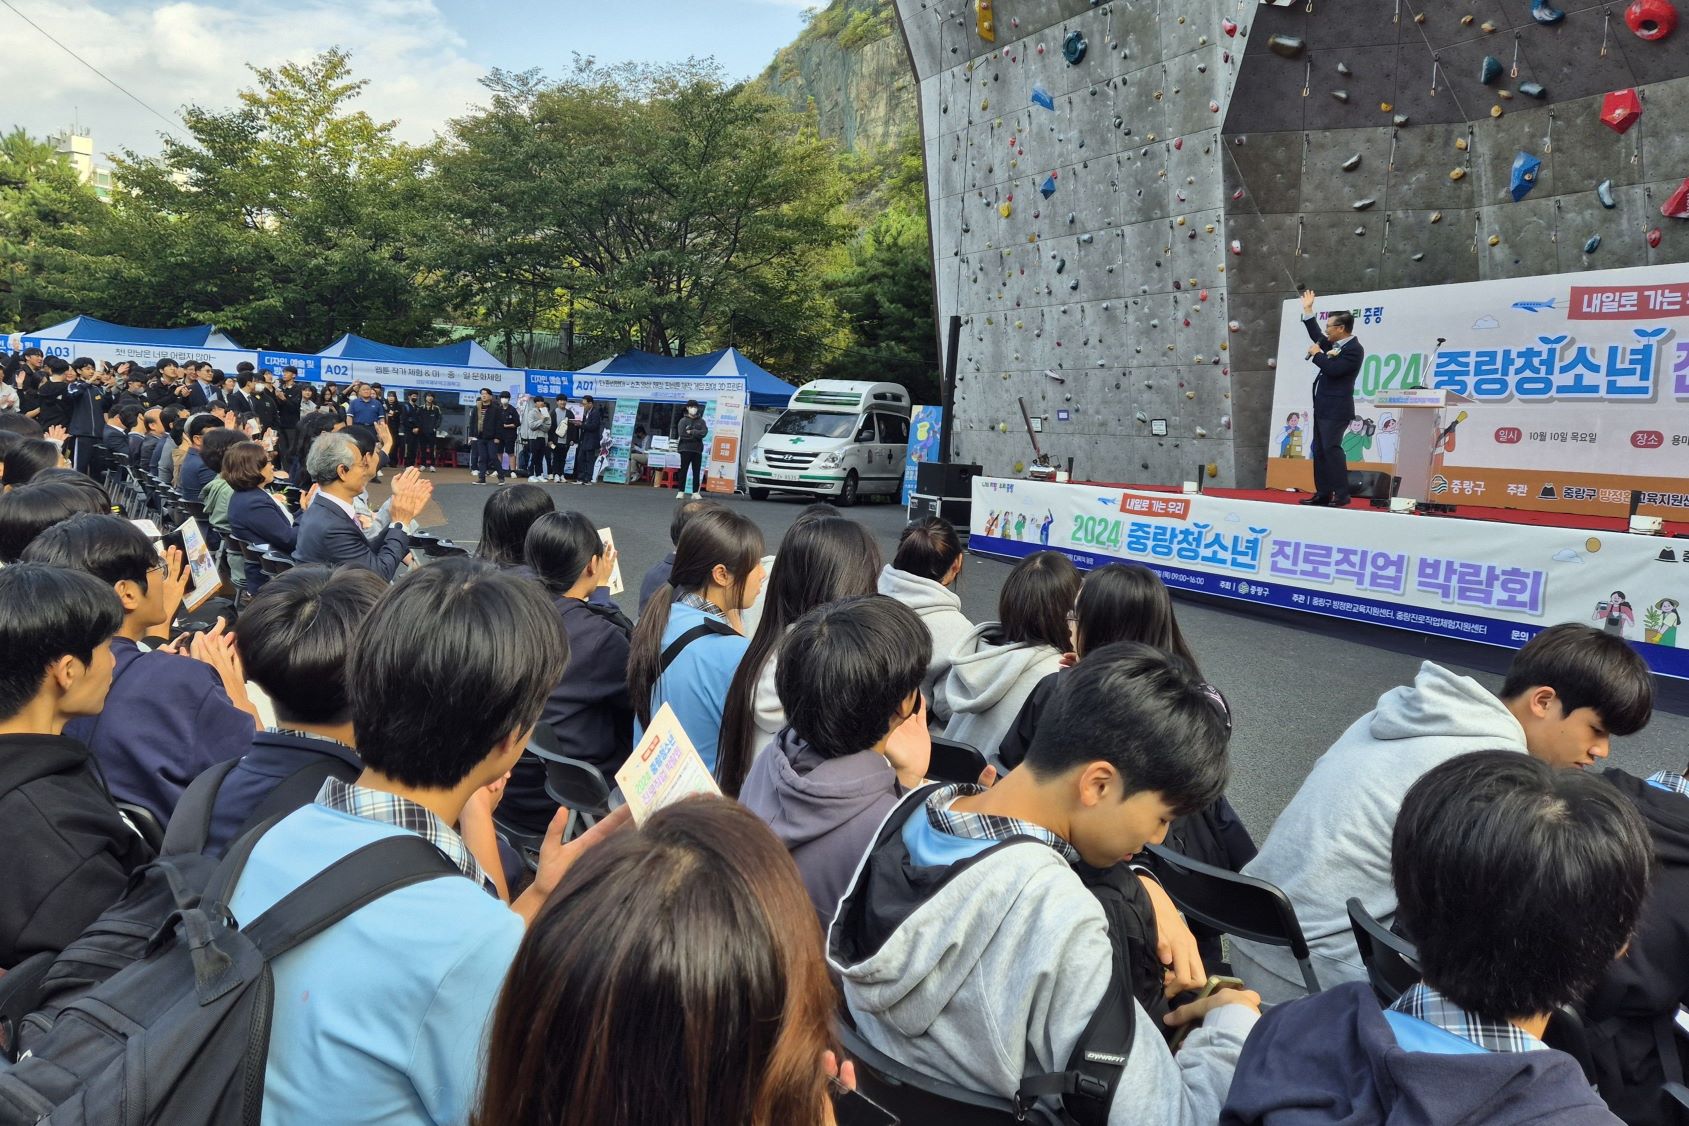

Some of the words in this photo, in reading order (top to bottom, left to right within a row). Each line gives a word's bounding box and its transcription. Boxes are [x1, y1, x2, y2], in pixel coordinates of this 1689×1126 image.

[1583, 292, 1638, 312] 내일로
[1644, 289, 1682, 310] 가는
[1364, 307, 1384, 325] 중랑
[45, 346, 70, 358] A03
[127, 349, 151, 358] 만남은
[265, 357, 289, 366] 디자인
[290, 359, 305, 368] 예술
[306, 360, 315, 369] 및
[1434, 342, 1652, 396] 중랑청소년
[325, 365, 348, 376] A02
[374, 366, 391, 375] 웹툰
[391, 367, 407, 375] 작가
[408, 368, 423, 377] 체험
[472, 372, 502, 382] 문화체험
[530, 375, 549, 384] 디자인
[549, 376, 562, 385] 예술
[562, 377, 569, 385] 및
[576, 381, 594, 390] A01
[726, 382, 743, 391] 프린터
[537, 384, 549, 393] 방송
[1499, 430, 1519, 442] 일시
[1529, 432, 1547, 442] 10월
[1549, 432, 1568, 442] 10일
[1570, 432, 1597, 443] 목요일
[1635, 433, 1658, 445] 장소
[1451, 480, 1486, 495] 중랑구
[1507, 483, 1528, 496] 주관
[1563, 486, 1598, 500] 중랑구
[1126, 498, 1149, 511] 내일로
[1151, 500, 1167, 513] 가는
[1168, 502, 1185, 514] 우리
[1070, 514, 1122, 548] 2024
[1126, 521, 1261, 571] 중랑청소년
[1270, 539, 1405, 592] 진로직업
[1417, 557, 1543, 613] 박람회
[1219, 580, 1232, 590] 주최
[1250, 585, 1270, 597] 중랑구
[1292, 594, 1305, 603] 주관
[1312, 597, 1332, 608] 중랑구
[1396, 610, 1488, 635] 중랑진로직업체험지원센터
[1511, 629, 1529, 642] 문의
[1087, 1052, 1126, 1063] DYNAFIT
